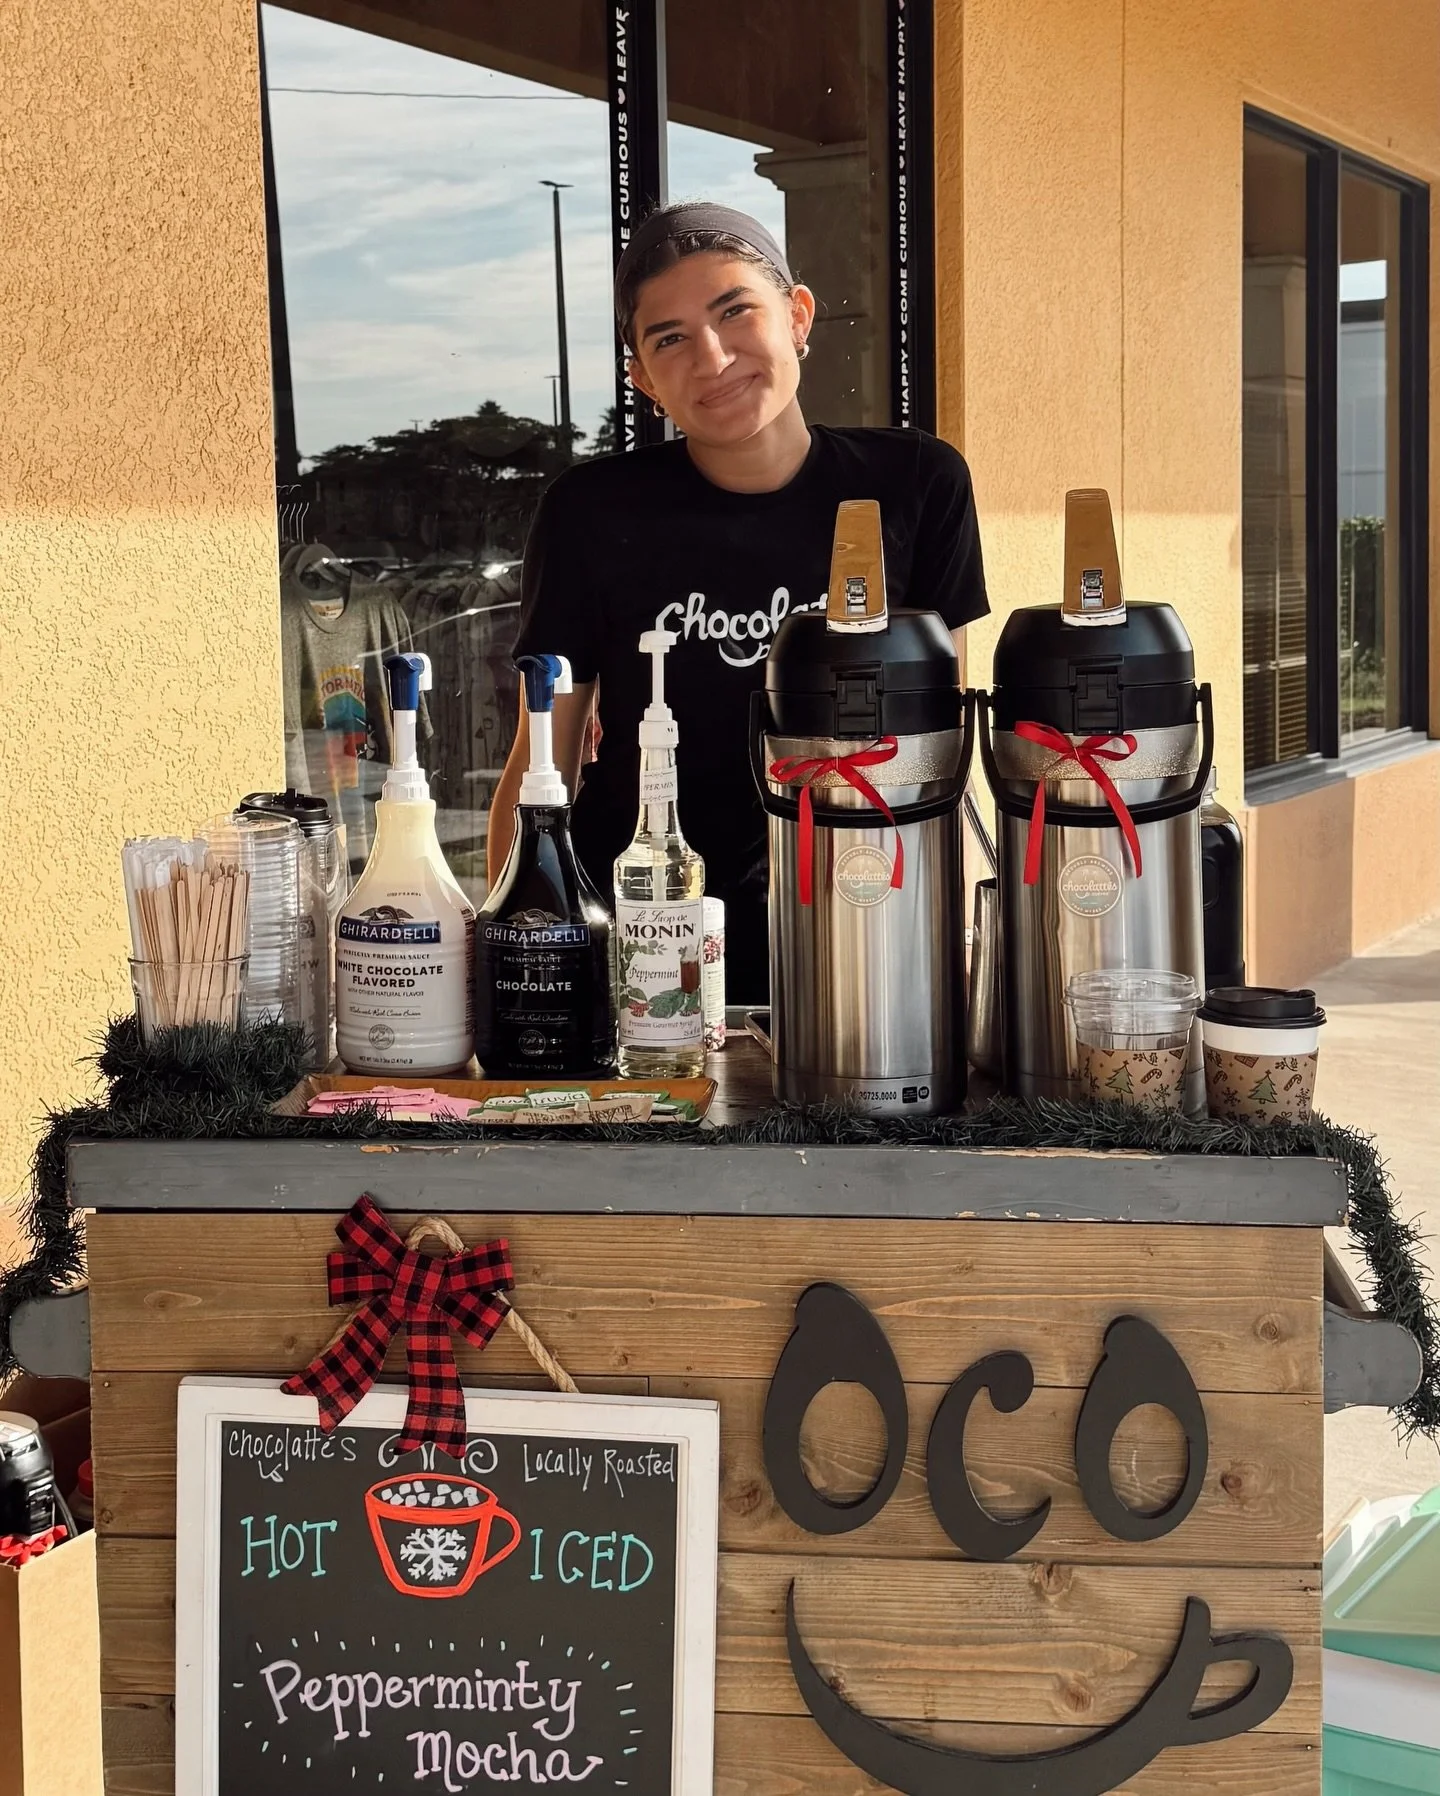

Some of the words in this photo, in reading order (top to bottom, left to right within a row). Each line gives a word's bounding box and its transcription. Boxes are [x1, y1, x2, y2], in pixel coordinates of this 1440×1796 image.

[615, 6, 630, 83] LEAVE
[897, 15, 905, 85] HAPPY
[898, 90, 906, 151] LEAVE
[617, 111, 630, 220] CURIOUS
[899, 174, 907, 263] CURIOUS
[900, 268, 908, 325] COME
[901, 348, 909, 414] HAPPY
[341, 922, 436, 940] GHIRARDELLI
[485, 927, 585, 943] GHIRARDELLI
[625, 923, 694, 938] MONIN
[338, 960, 362, 974] WHITE
[367, 965, 444, 976] CHOCOLATE
[352, 975, 416, 988] FLAVORED
[496, 980, 572, 992] CHOCOLATE
[523, 1443, 592, 1492] Locally
[604, 1446, 675, 1498] Roasted
[240, 1514, 338, 1579] HOT
[530, 1528, 654, 1592] ICED
[259, 1659, 582, 1741] Pepperminty
